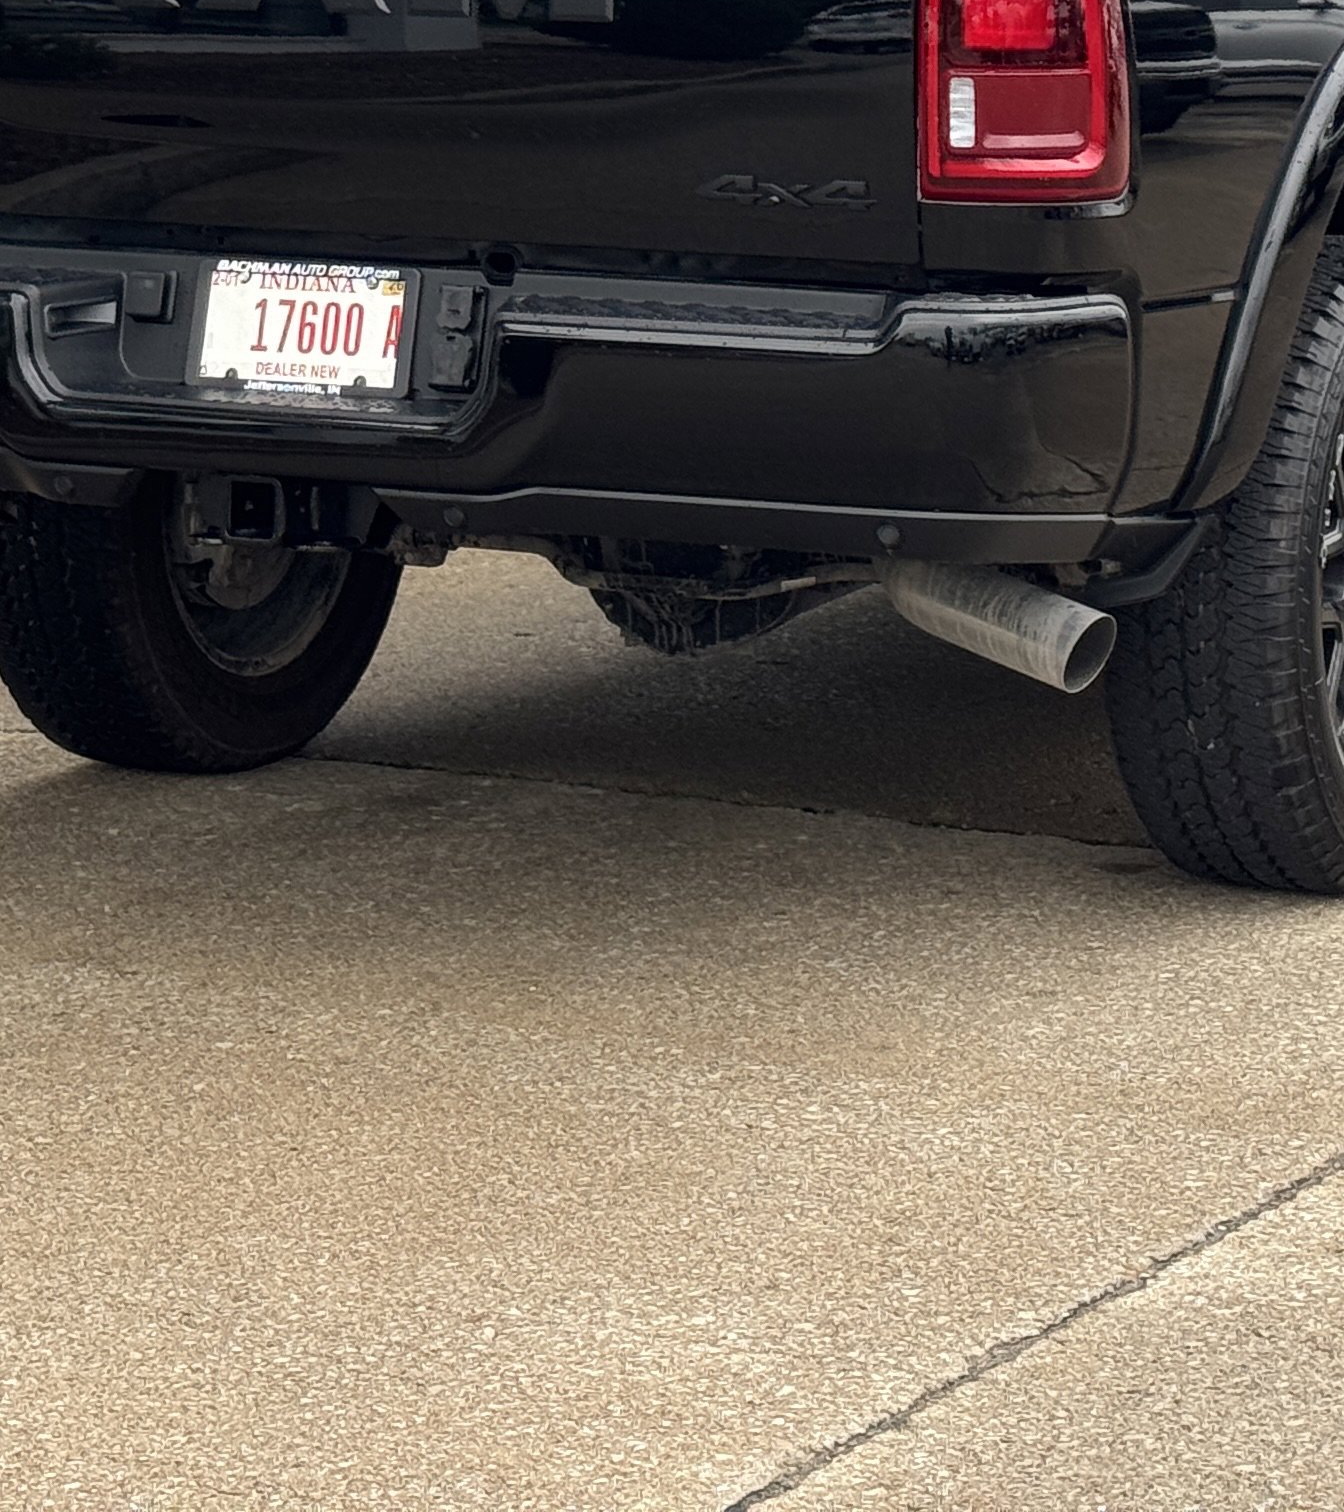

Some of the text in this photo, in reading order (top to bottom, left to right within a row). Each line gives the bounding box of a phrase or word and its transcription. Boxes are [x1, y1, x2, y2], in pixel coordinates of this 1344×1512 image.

[291, 263, 327, 276] AUTO
[259, 273, 356, 293] INDIANA
[250, 298, 364, 356] 17600
[256, 362, 340, 379] DEALER NEW
